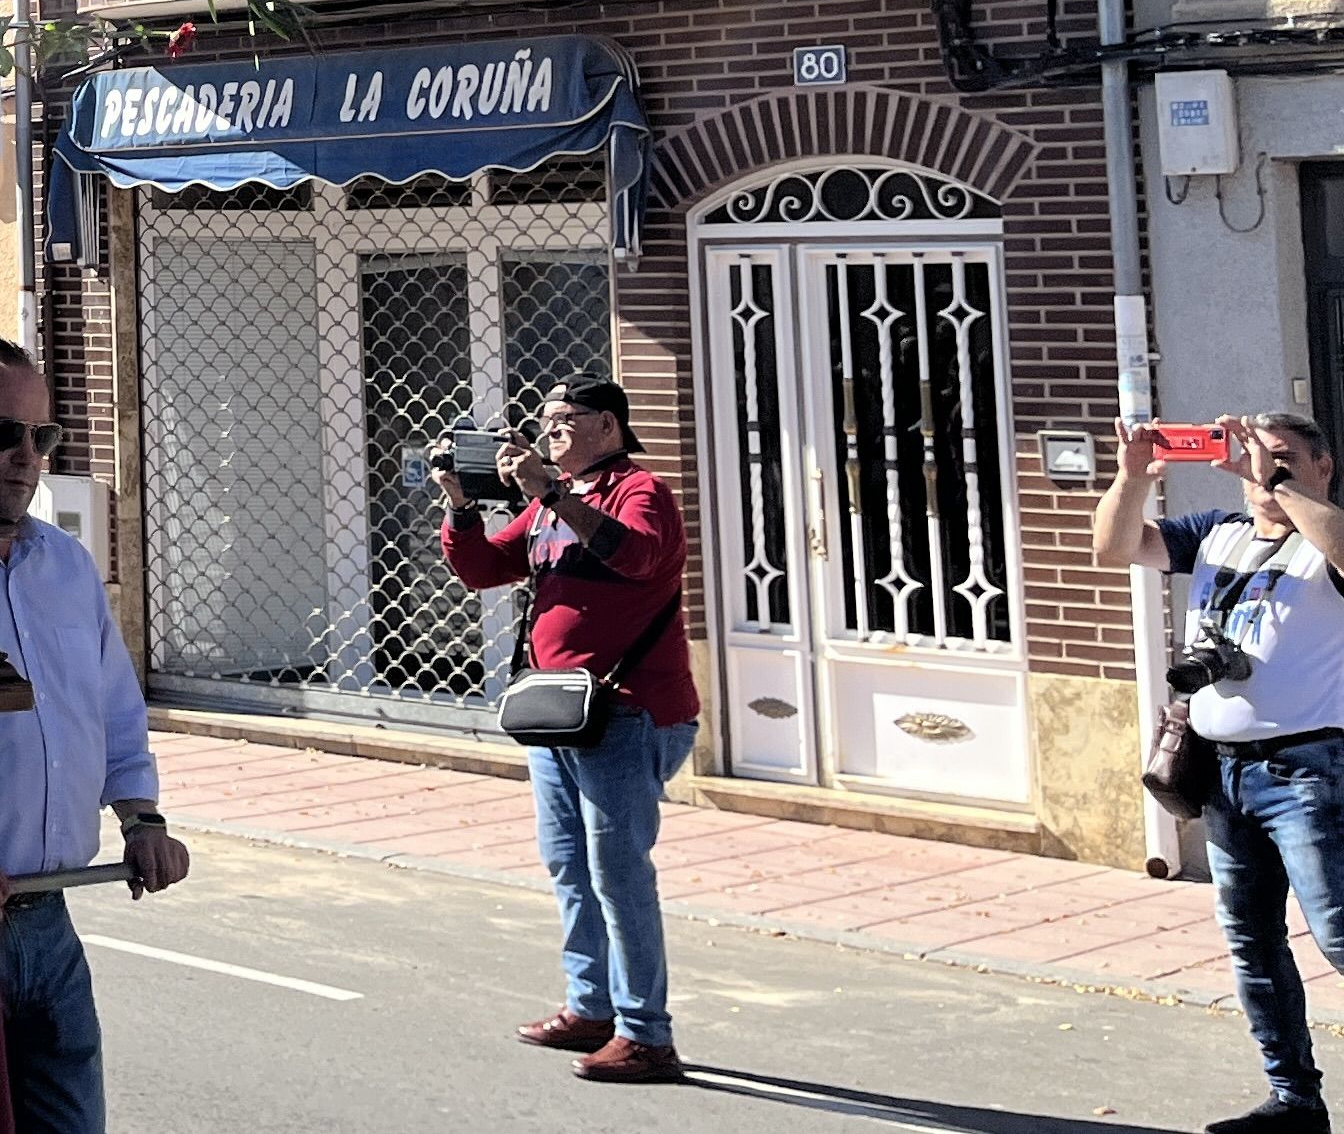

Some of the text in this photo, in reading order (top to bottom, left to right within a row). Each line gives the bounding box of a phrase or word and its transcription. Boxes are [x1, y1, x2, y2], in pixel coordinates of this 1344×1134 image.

[101, 47, 552, 138] PESCADERIA LA CORUÑA
[800, 51, 839, 80] 80
